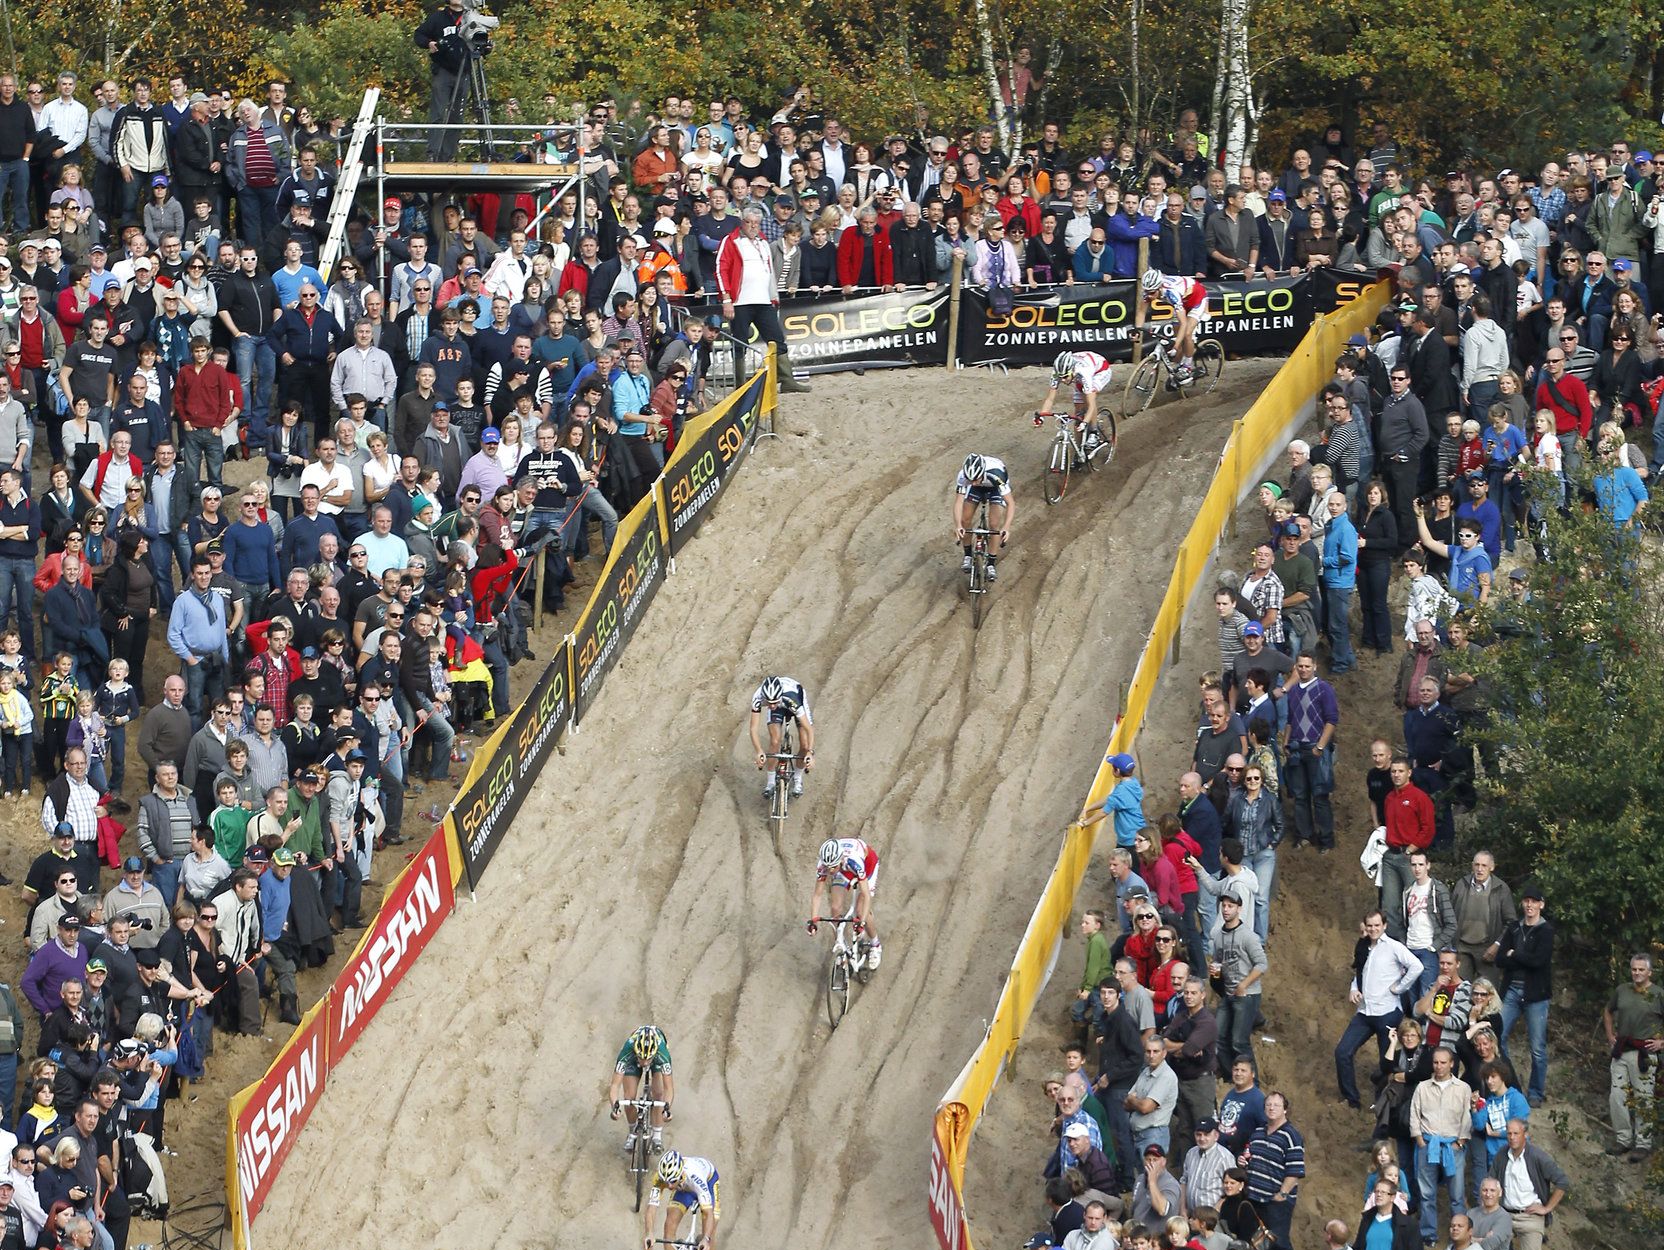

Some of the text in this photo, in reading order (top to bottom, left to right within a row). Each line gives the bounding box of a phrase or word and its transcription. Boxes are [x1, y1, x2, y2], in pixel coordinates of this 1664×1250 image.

[784, 302, 937, 341] SOLECO
[984, 326, 1129, 347] ZONNEPANELEN
[985, 300, 1128, 328] SOLECO
[1150, 288, 1294, 320] SLECO
[1151, 315, 1294, 338] ZONEPANELEN
[787, 330, 938, 358] ZONNEPANELEN
[671, 450, 715, 513] SOLECO
[673, 476, 721, 532] ZONNEPANELEN
[618, 530, 657, 607] SOLECO
[623, 558, 659, 627] ZONNEPANELEN
[579, 600, 617, 678] SOLECO
[580, 629, 621, 698] ZONNEPANELEN
[519, 672, 564, 754] SOLECO
[519, 697, 565, 779] ZONNEPANELEN
[462, 754, 513, 844] SOLECO
[469, 783, 516, 862] ZONNEPANELEN
[338, 855, 442, 1042] NISSAN
[240, 1033, 319, 1203] NISSAN
